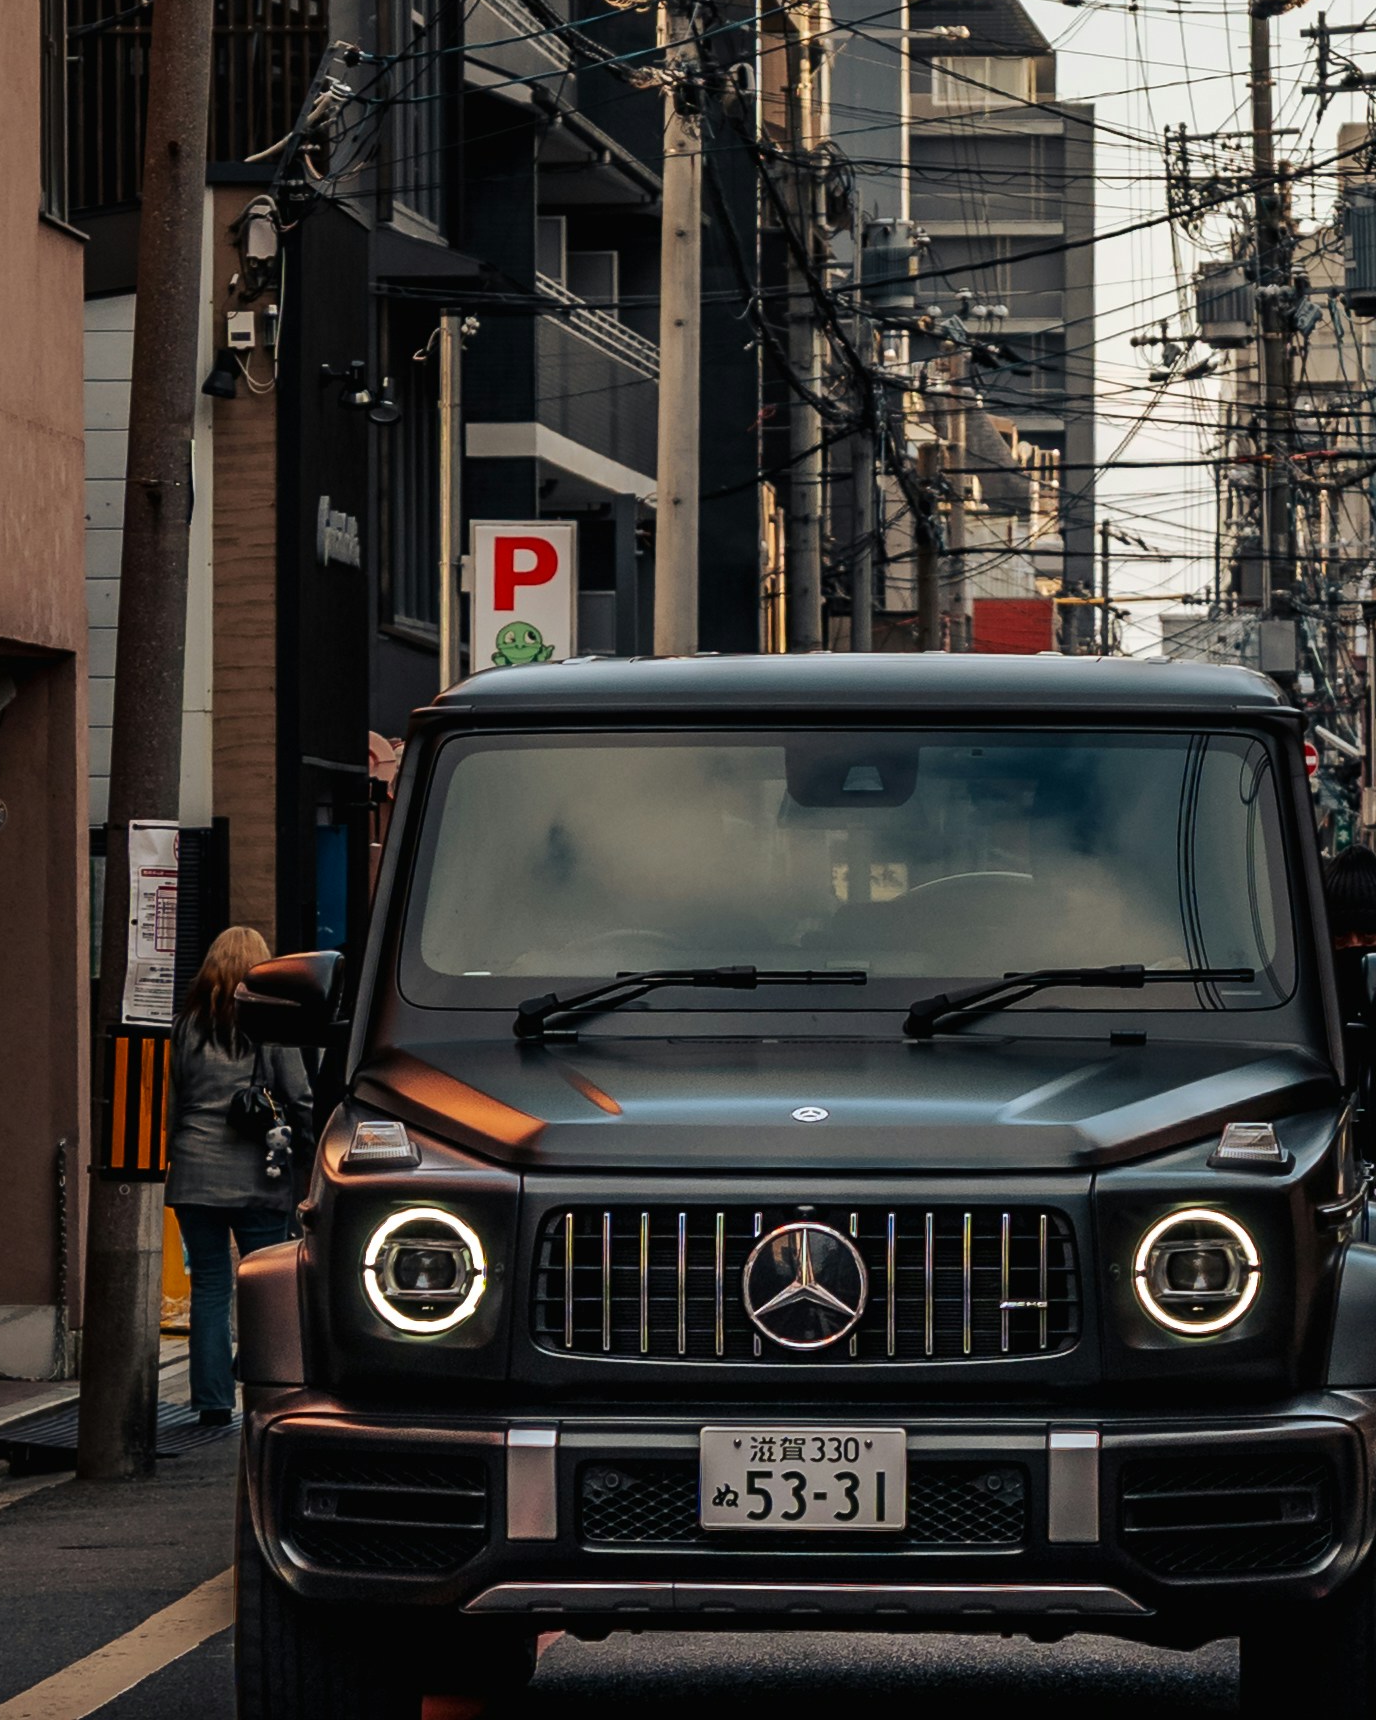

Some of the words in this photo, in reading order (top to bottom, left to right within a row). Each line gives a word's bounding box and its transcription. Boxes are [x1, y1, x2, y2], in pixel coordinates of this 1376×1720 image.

[494, 537, 558, 610] P
[712, 1483, 739, 1508] ぬ
[746, 1470, 885, 1522] 53-31
